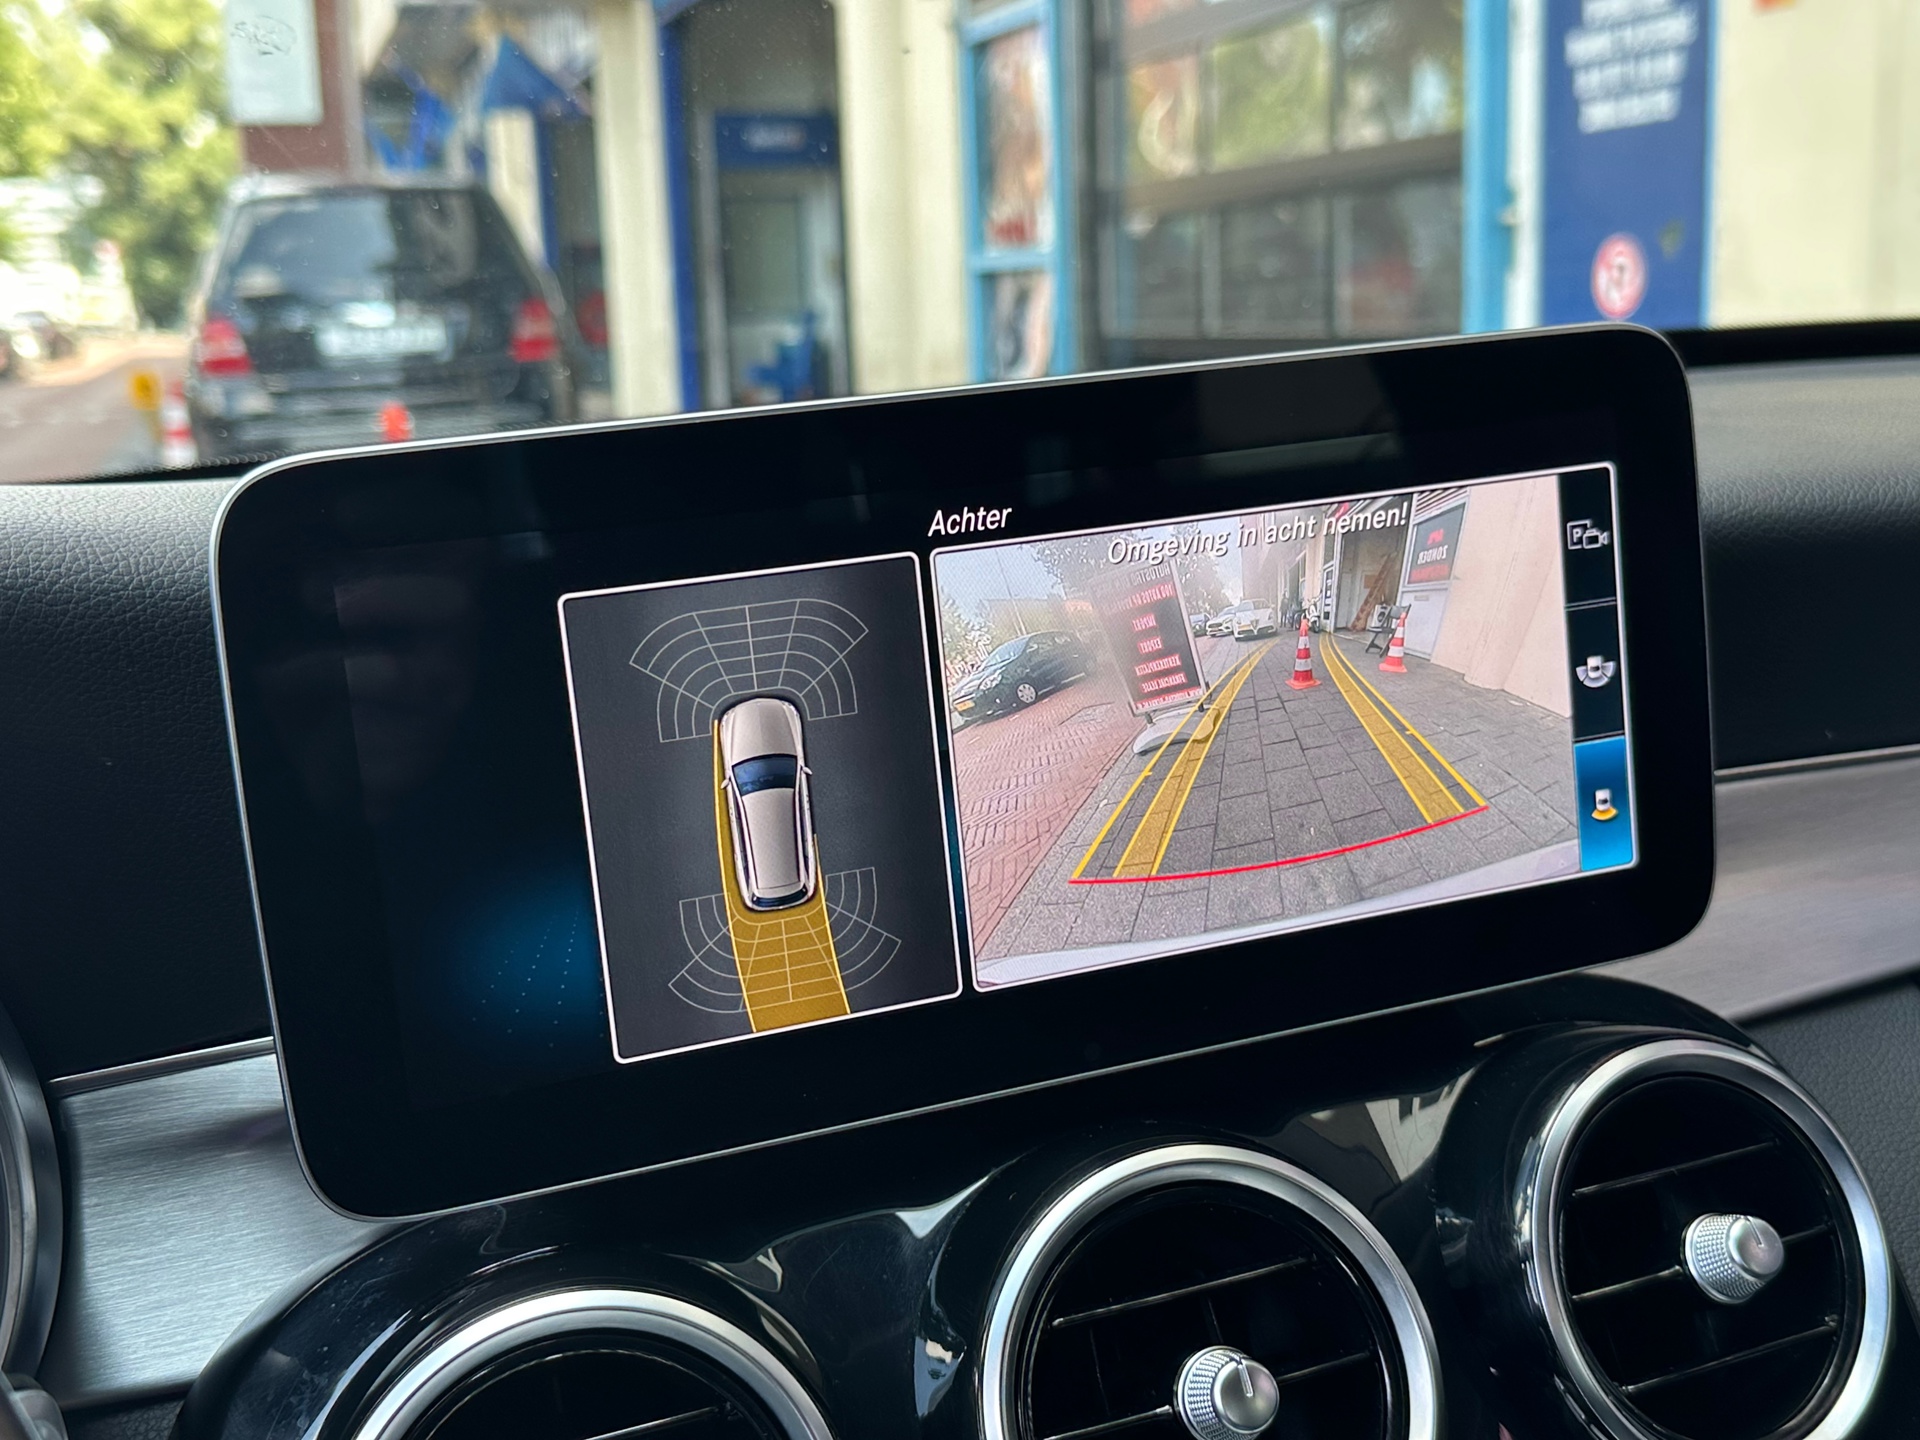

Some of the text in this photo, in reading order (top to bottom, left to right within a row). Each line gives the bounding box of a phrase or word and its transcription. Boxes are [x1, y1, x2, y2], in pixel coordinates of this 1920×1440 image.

[928, 506, 1013, 537] Achter
[1107, 501, 1408, 565] Omgeving in acht nemen!
